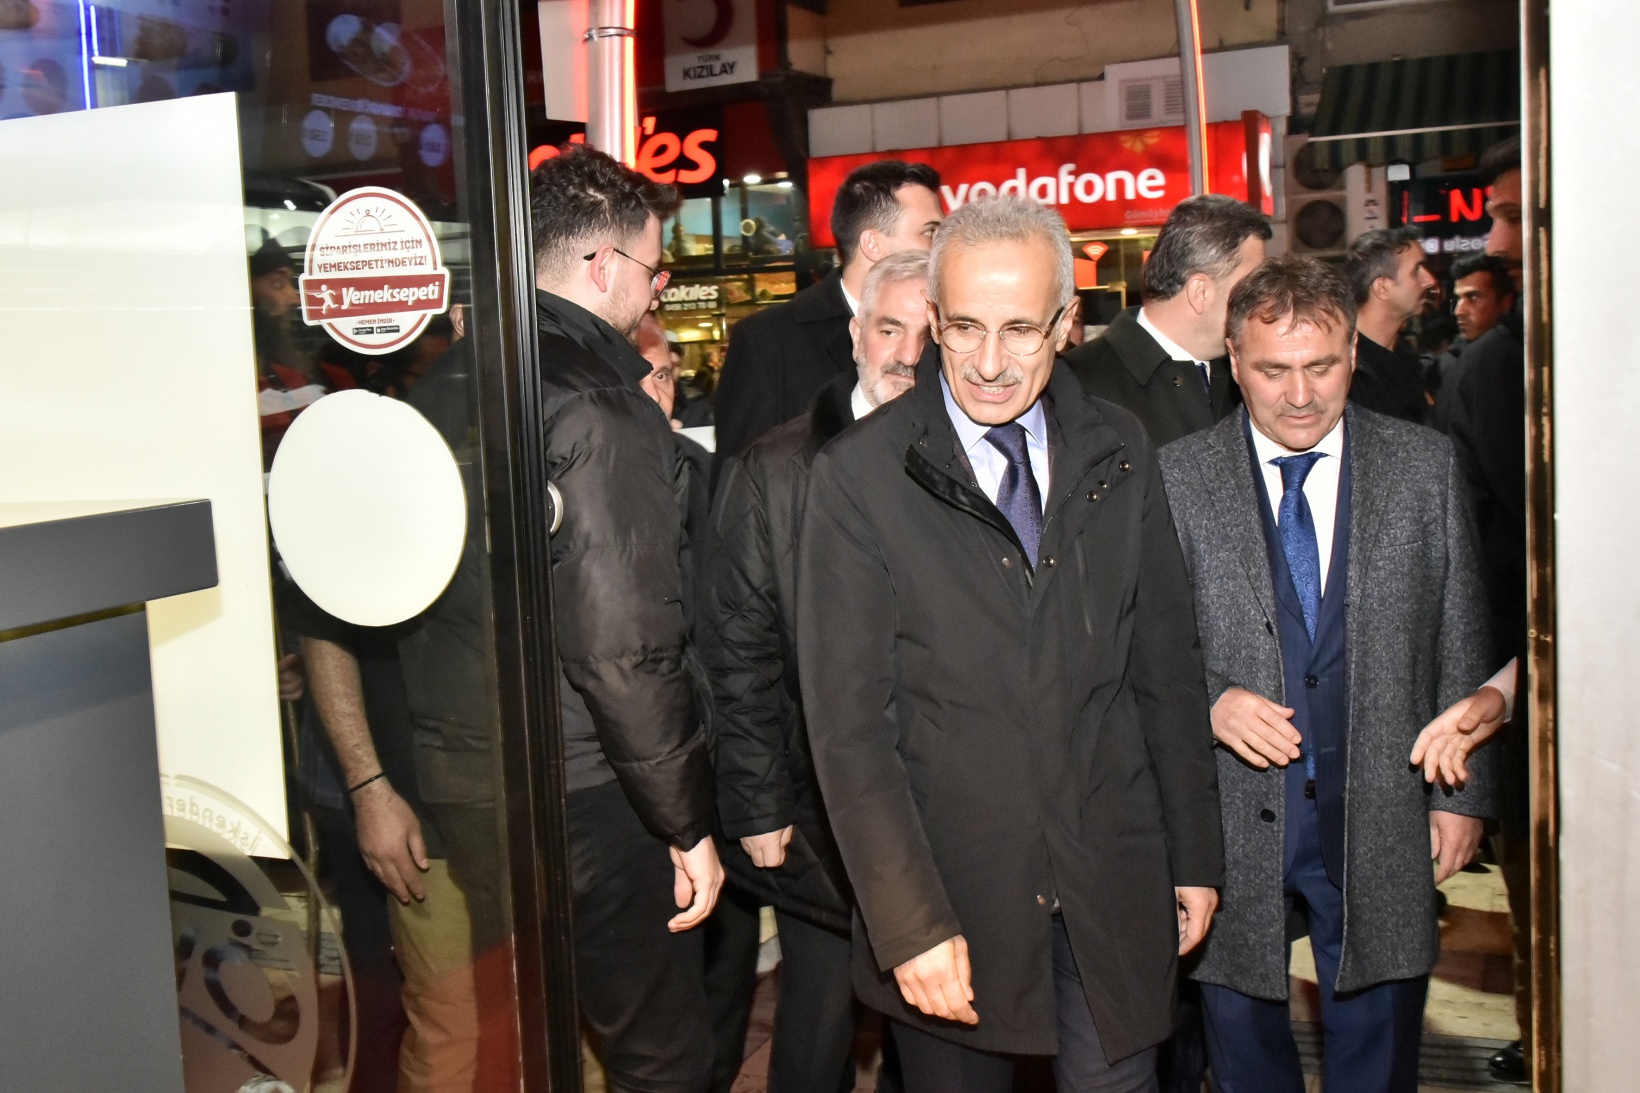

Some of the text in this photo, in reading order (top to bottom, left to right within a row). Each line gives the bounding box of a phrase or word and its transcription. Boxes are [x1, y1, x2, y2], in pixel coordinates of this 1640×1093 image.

[682, 61, 738, 81] KIZILAY
[940, 163, 1166, 213] vodafone
[400, 236, 423, 253] İÇİN
